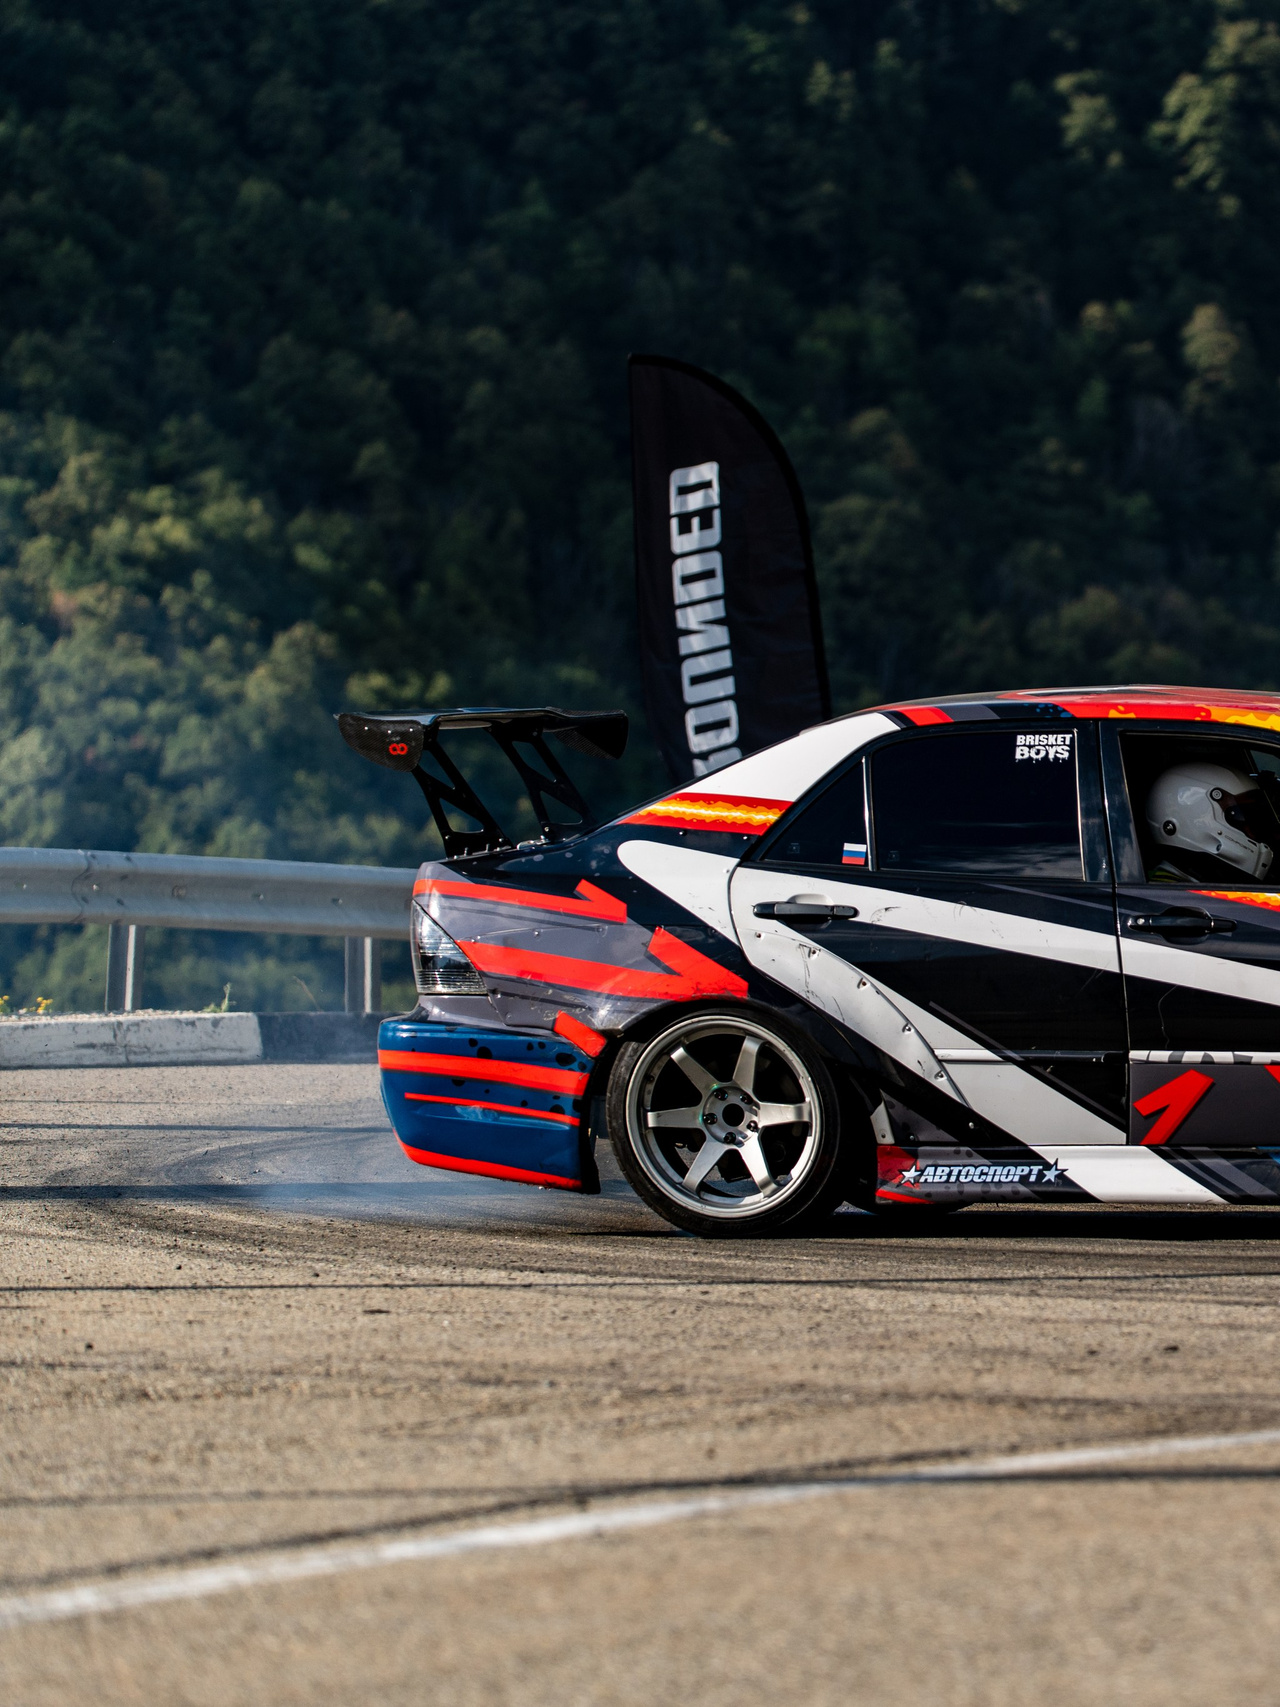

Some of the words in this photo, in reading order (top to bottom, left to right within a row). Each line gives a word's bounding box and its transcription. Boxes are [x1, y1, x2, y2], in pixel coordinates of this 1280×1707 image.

[1016, 734, 1073, 746] BRISKET
[1015, 745, 1071, 762] BOYS
[918, 1165, 1043, 1184] АВТОСПОРТ
